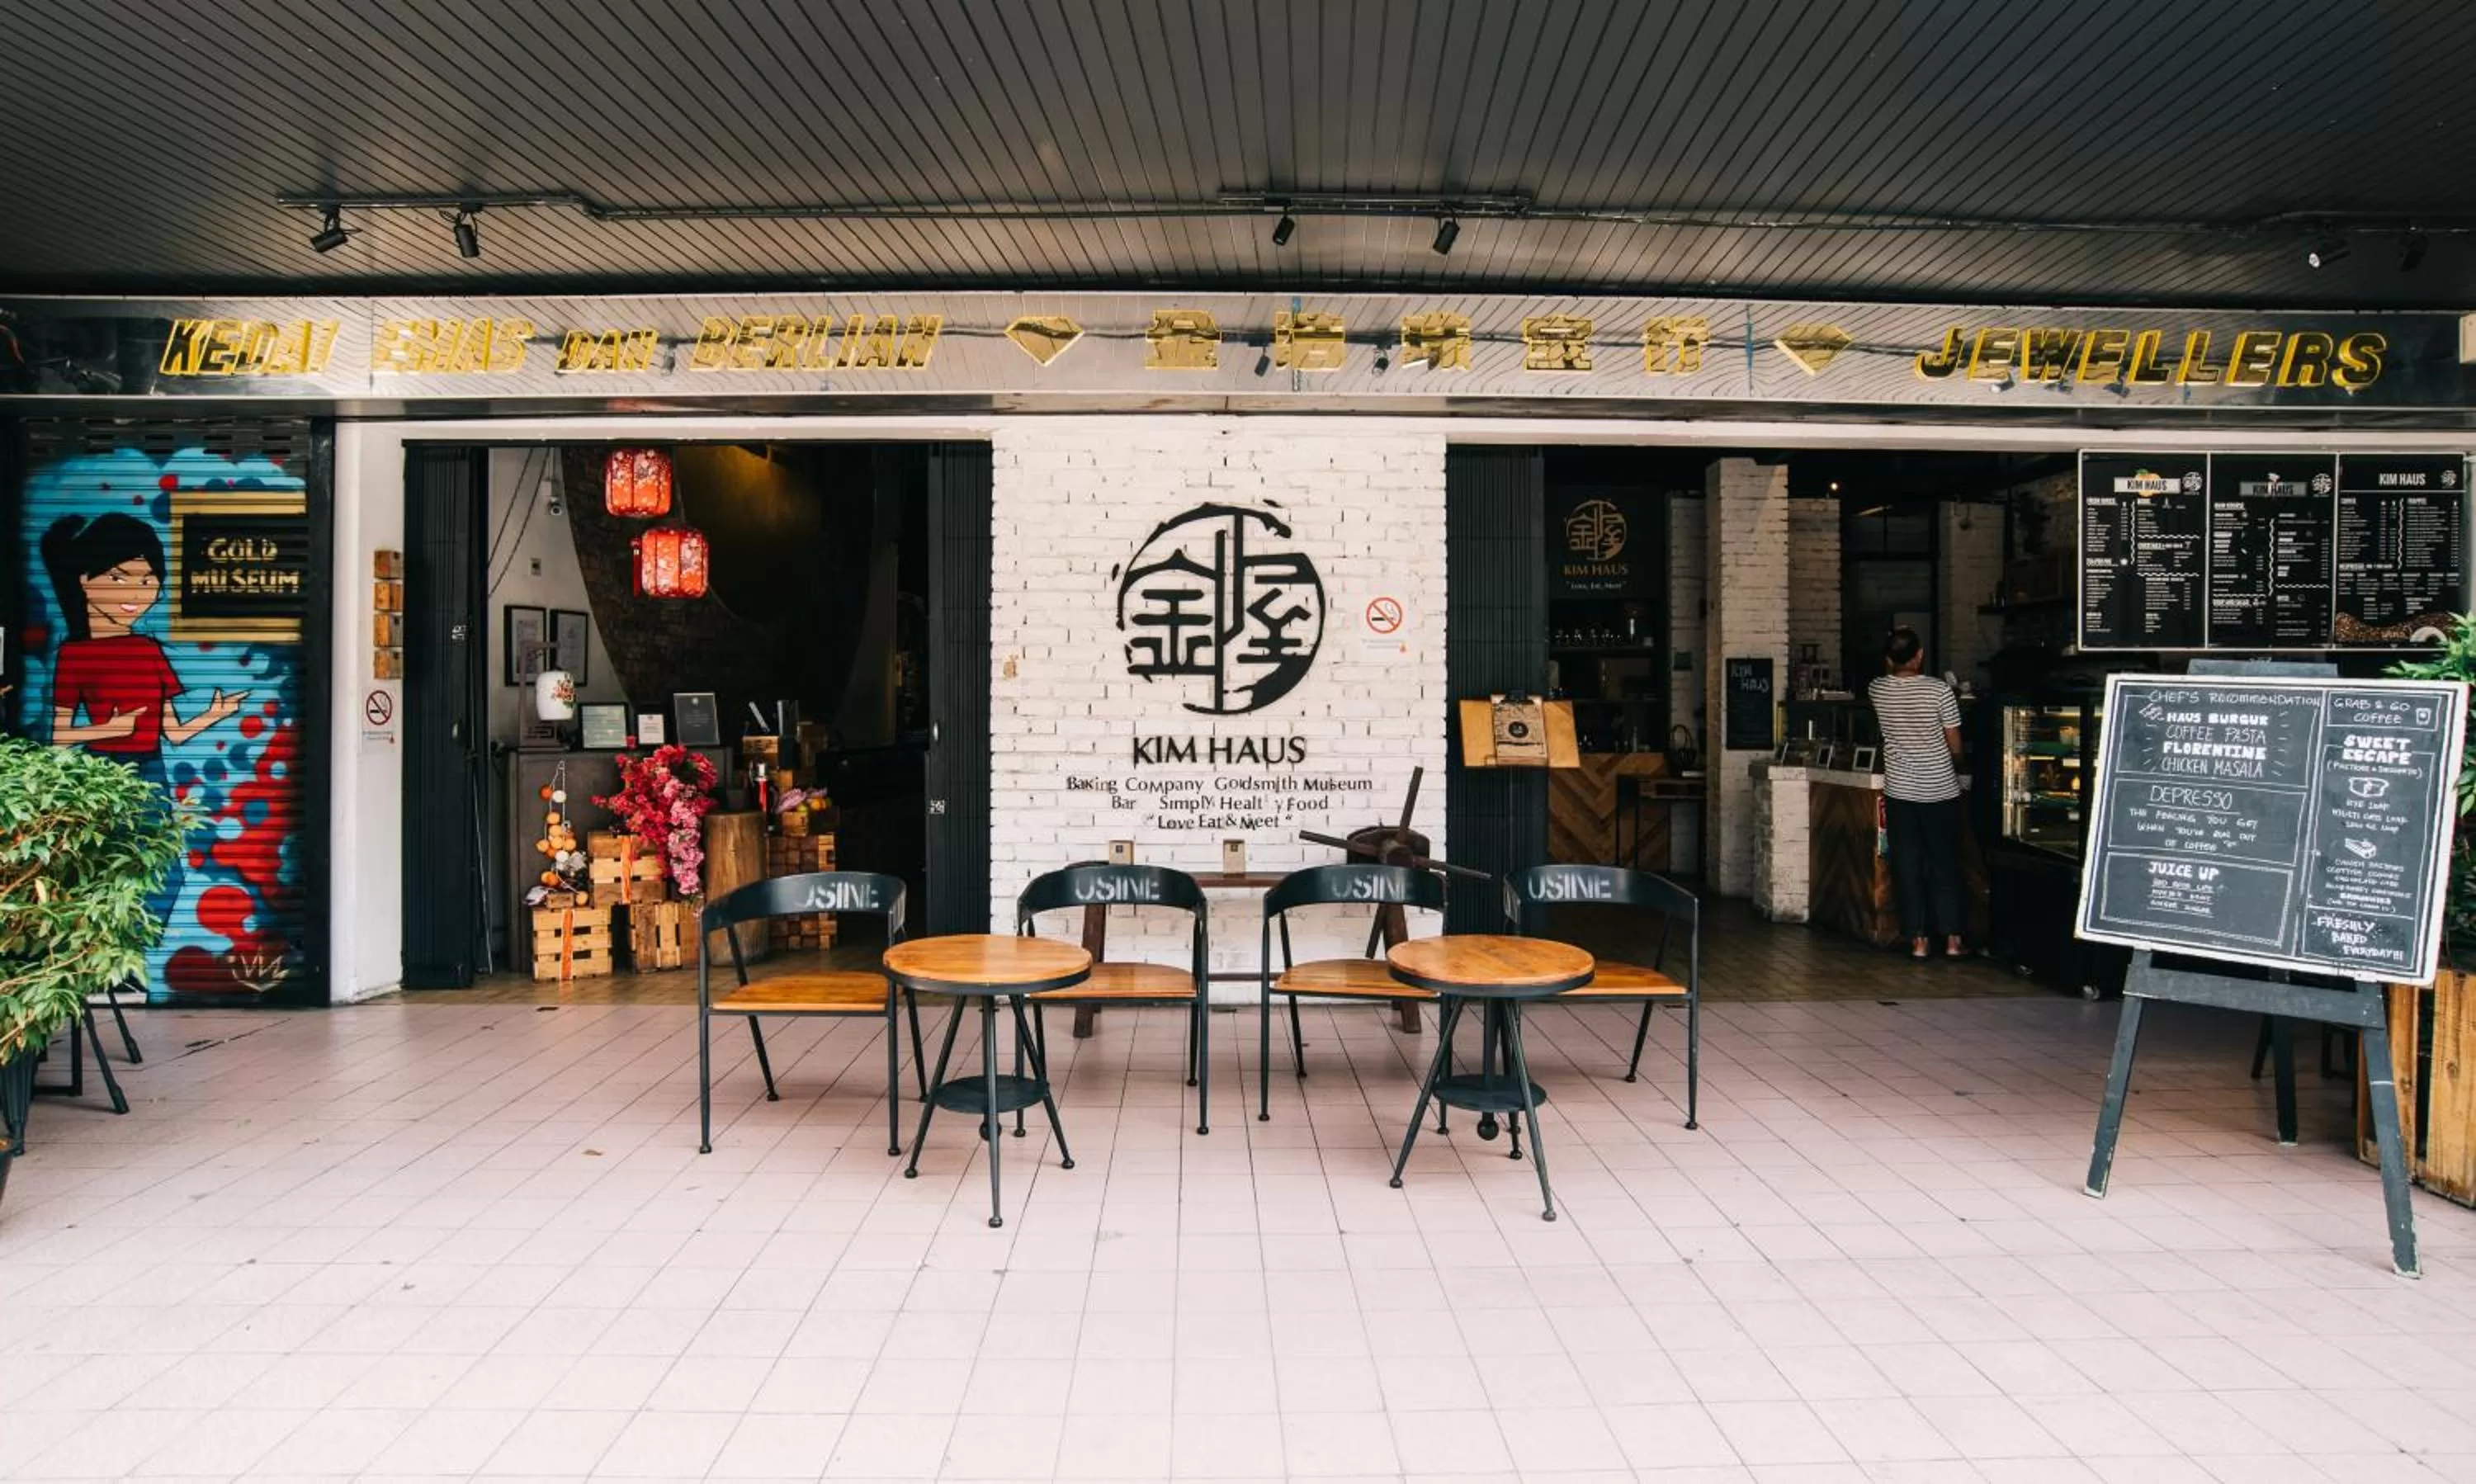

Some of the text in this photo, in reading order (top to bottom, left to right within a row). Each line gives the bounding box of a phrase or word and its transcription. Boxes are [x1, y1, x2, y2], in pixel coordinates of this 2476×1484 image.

[159, 314, 943, 376] KEDAI EMAS DAN BERLIAN
[1915, 328, 2387, 388] JEWELLERS
[2127, 480, 2168, 491] KIM HAUS
[2379, 473, 2426, 485] KIM HAUS
[208, 537, 279, 563] GOLD
[1564, 563, 1629, 576] KIM HAUS
[191, 568, 300, 594] MUSEUM
[2148, 689, 2200, 704] CHEF'S
[2333, 697, 2371, 711] GRAB
[2389, 701, 2411, 711] GO
[2166, 711, 2202, 724] HAUS
[2165, 725, 2267, 744] COFFEE PASTA
[2344, 734, 2412, 751] SWEET
[1132, 735, 1307, 764] KIM HAUS
[2162, 741, 2268, 760] FLORENTINE
[2342, 748, 2412, 766] ESCAPE
[2161, 756, 2263, 778] CHICKEN MASALA
[1111, 795, 1136, 810] Bar
[1220, 795, 1283, 814] Healty
[1287, 794, 1329, 811] Food
[2149, 785, 2233, 811] DEPRESSO
[2206, 815, 2228, 825] YOU
[2148, 861, 2220, 881] JUICE UP
[1075, 874, 1161, 901] USINE
[1529, 872, 1612, 899] USINE
[2316, 915, 2376, 933] FRESHLY
[2331, 930, 2368, 944] BAKED
